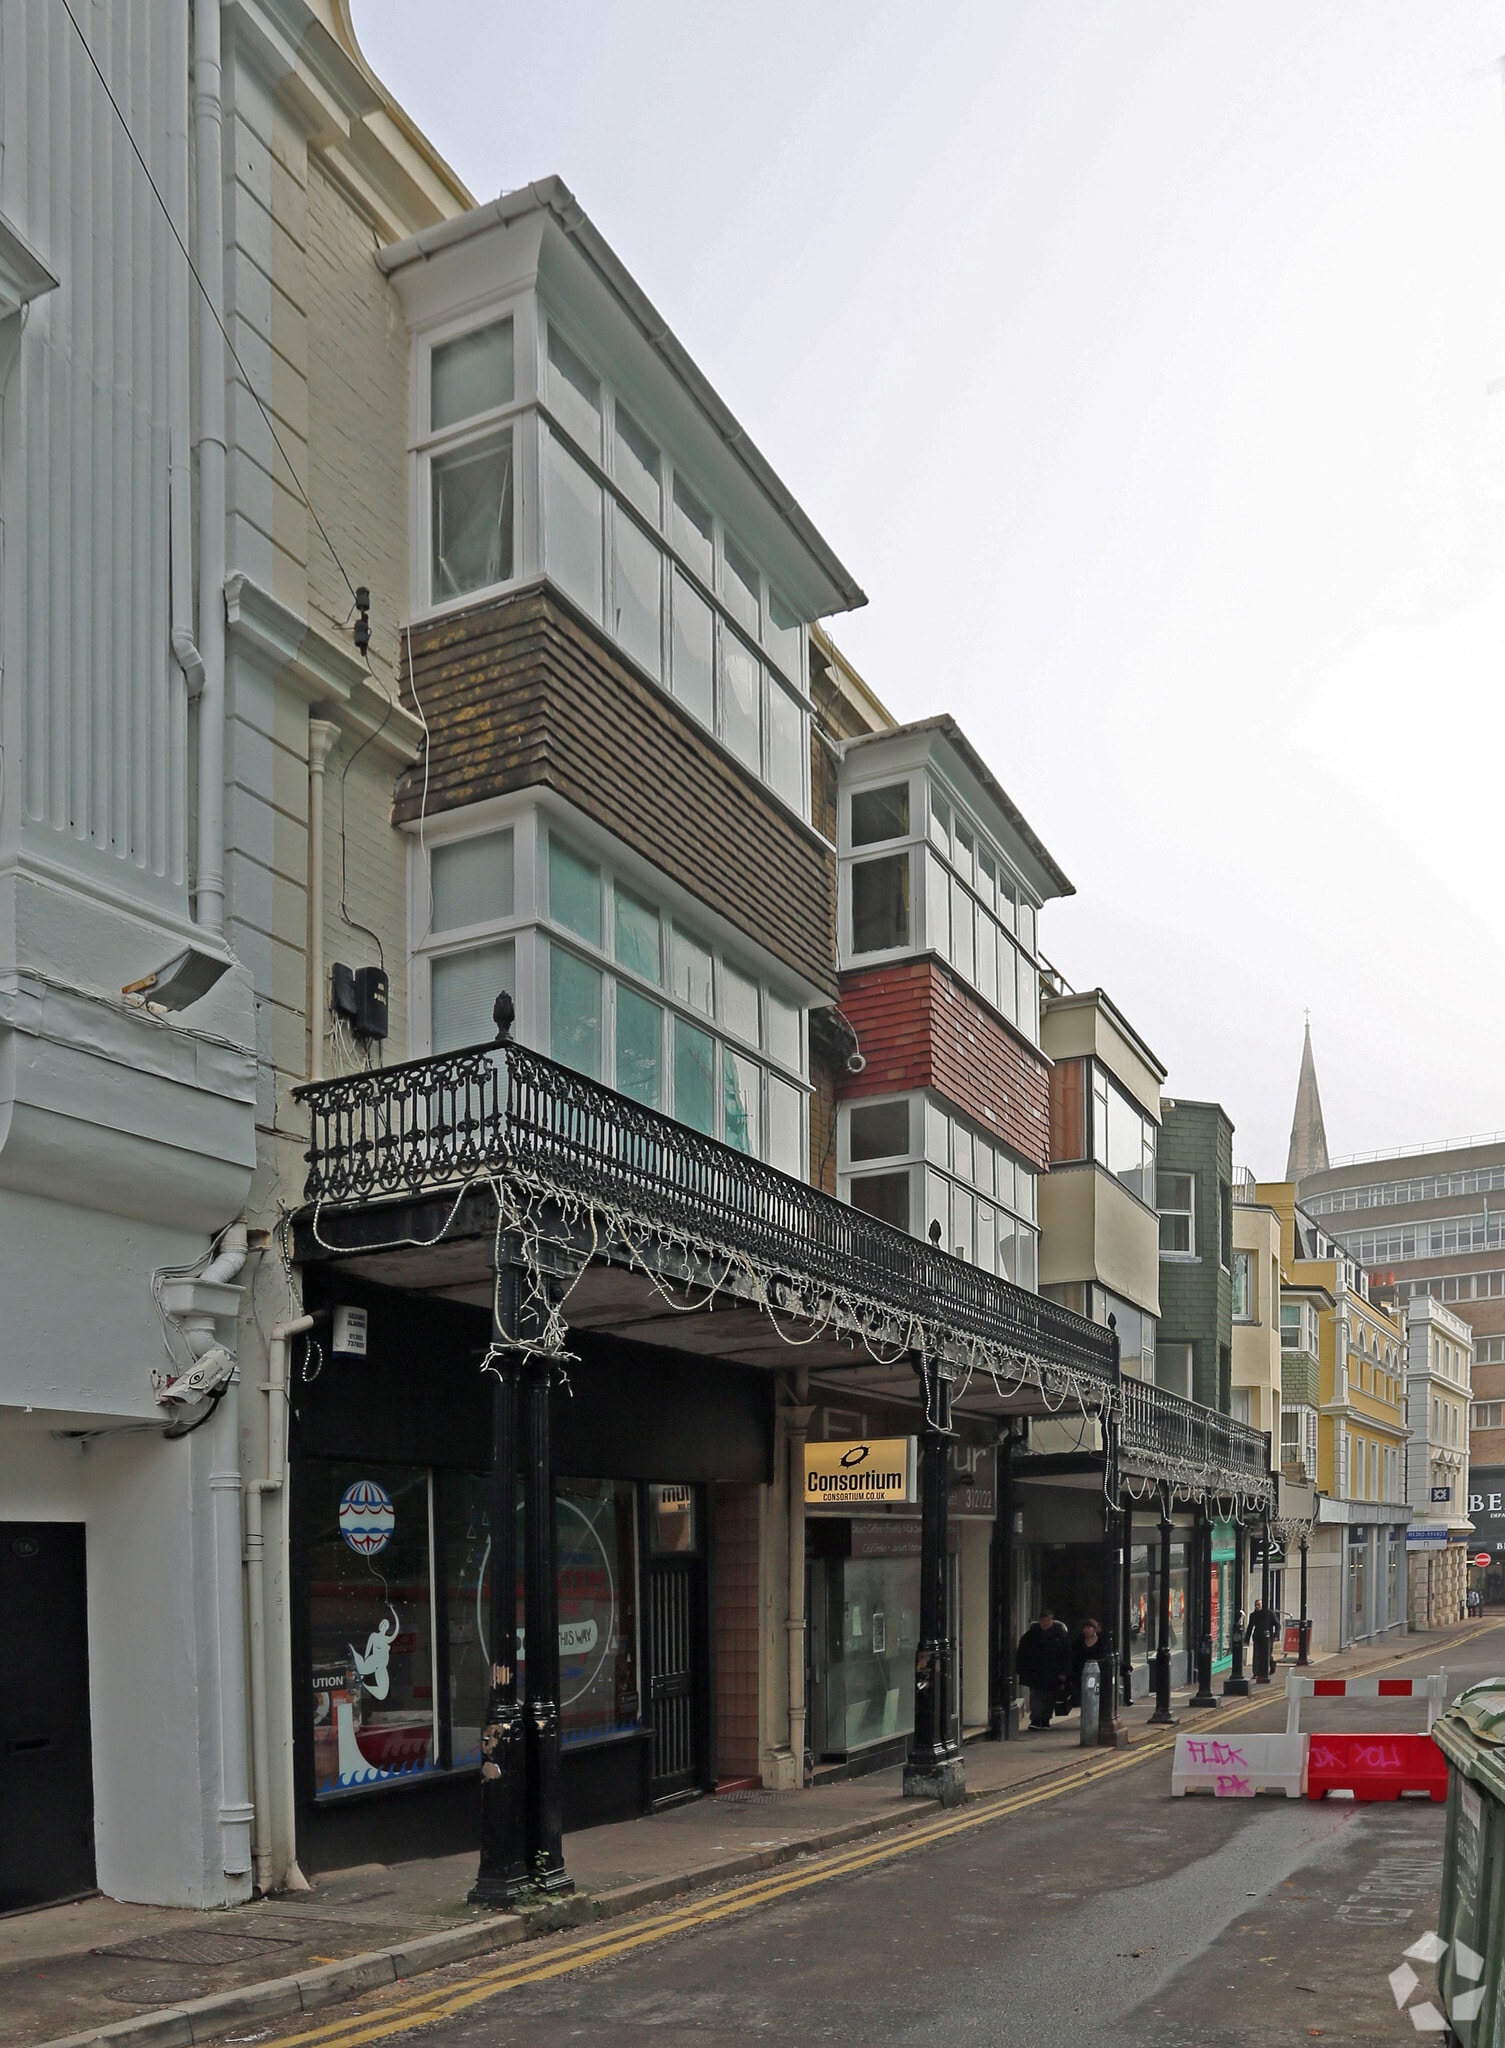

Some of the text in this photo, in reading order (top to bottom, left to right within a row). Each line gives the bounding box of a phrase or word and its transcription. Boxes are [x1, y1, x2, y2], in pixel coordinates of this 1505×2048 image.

[808, 1469, 902, 1492] Consortium
[823, 1492, 885, 1501] CONSORTIUM.CO.UK
[1468, 1493, 1505, 1512] BE
[575, 1628, 592, 1644] WAY
[312, 1675, 344, 1689] UTION
[1186, 1740, 1249, 1768] FUCK
[1353, 1743, 1401, 1768] YOU
[1216, 1775, 1255, 1796] DK
